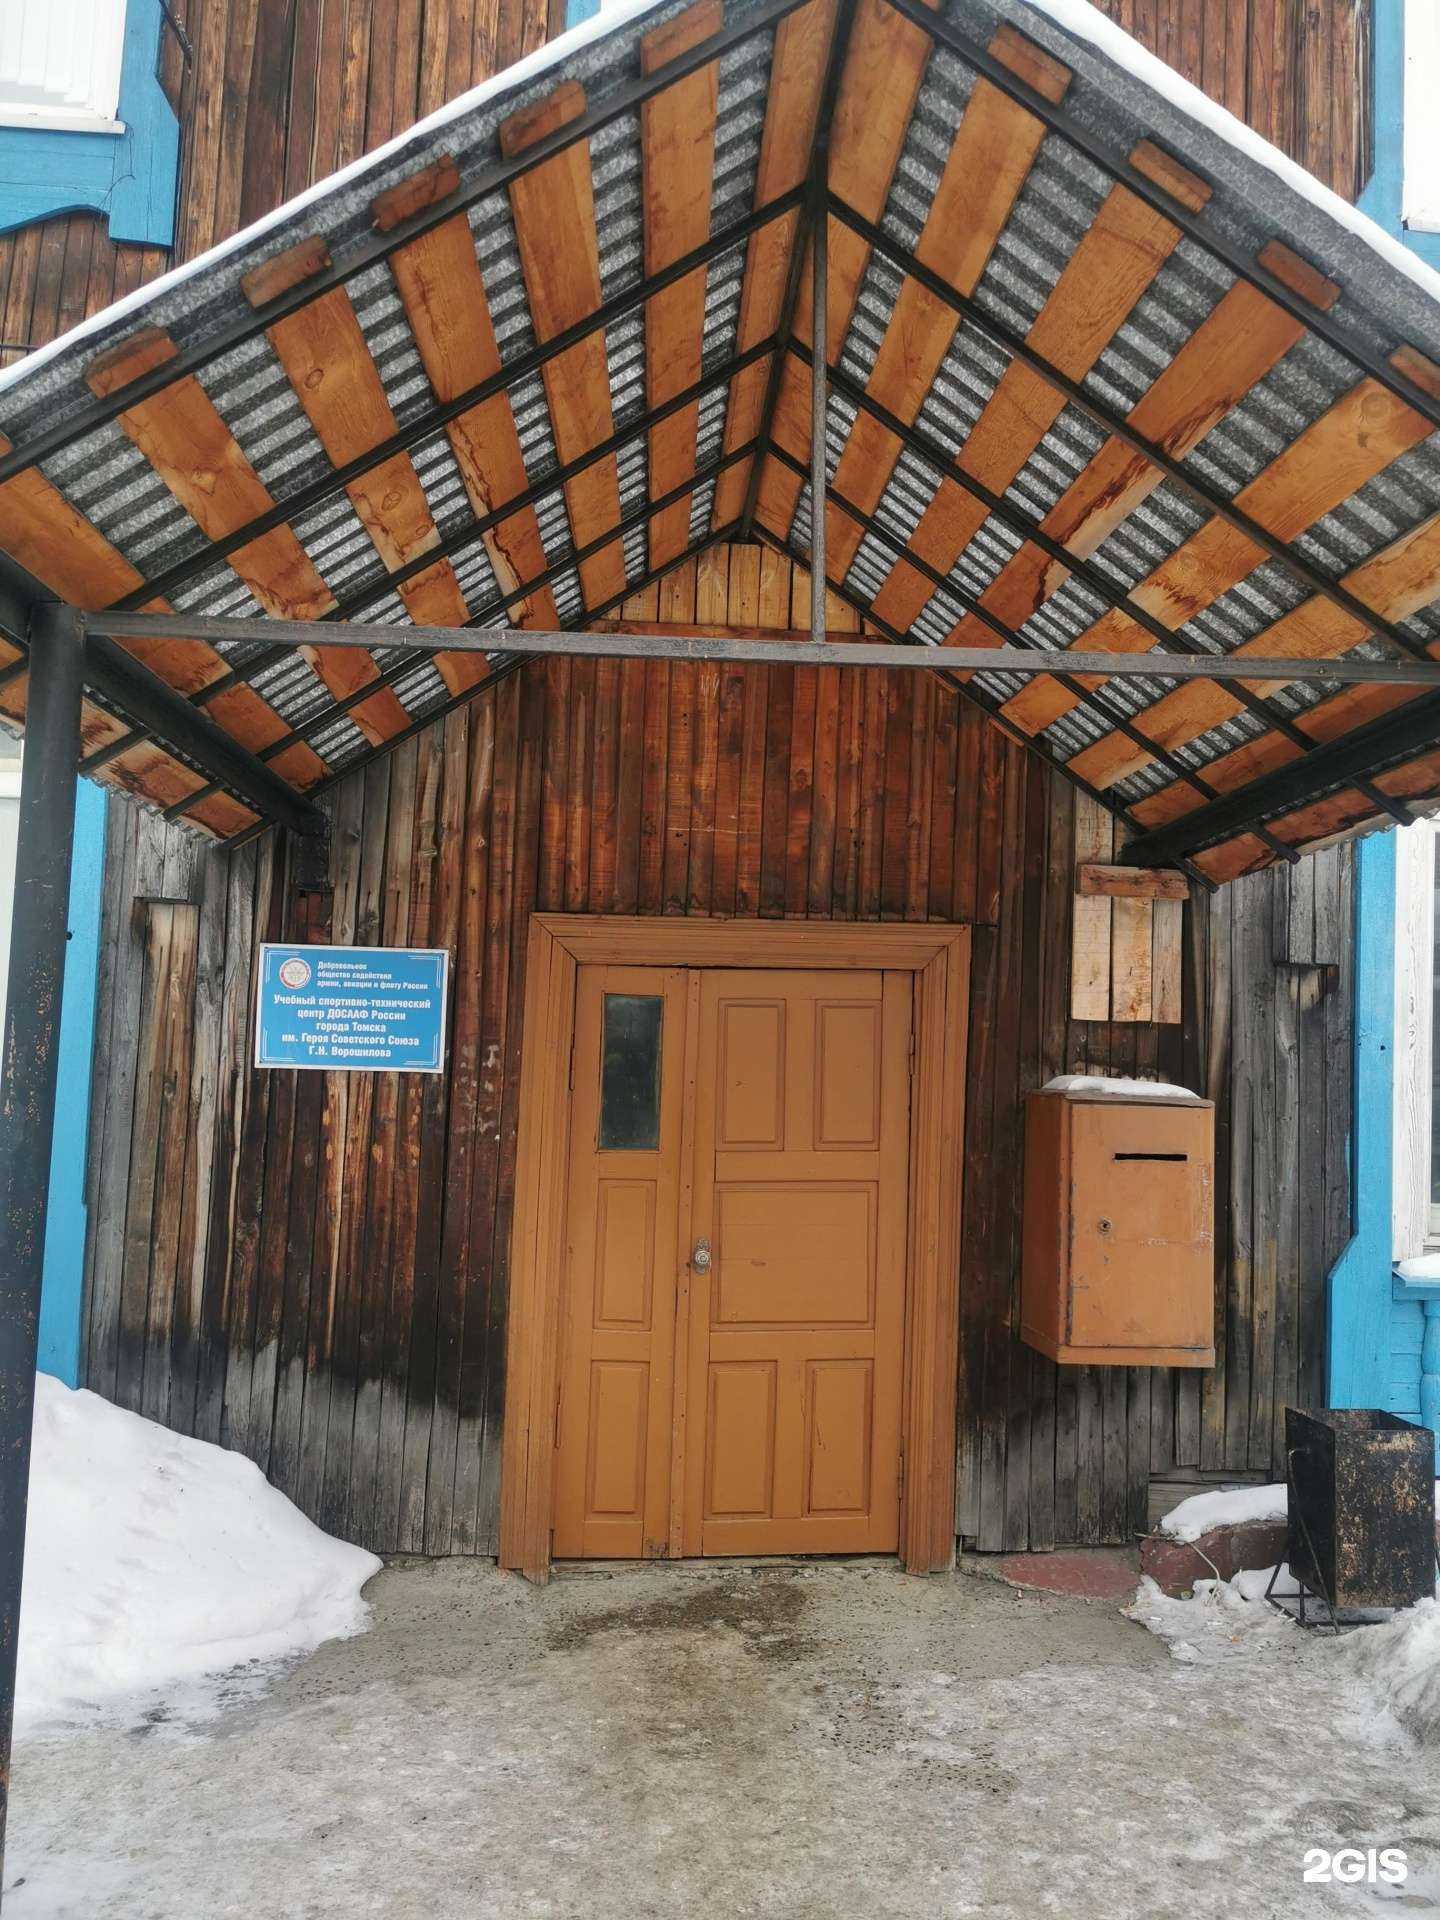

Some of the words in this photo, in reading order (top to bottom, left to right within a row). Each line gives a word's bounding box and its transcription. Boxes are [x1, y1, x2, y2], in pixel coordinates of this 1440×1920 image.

[380, 981, 401, 990] флоту
[402, 982, 428, 990] России
[274, 994, 316, 1005] Учебный
[318, 997, 431, 1009] спортивно-технический
[297, 1009, 325, 1019] центр
[327, 1009, 368, 1020] ДОСААФ
[371, 1011, 406, 1020] России
[316, 1022, 349, 1032] города
[352, 1022, 386, 1032] Томска
[282, 1034, 298, 1042] им.
[301, 1033, 328, 1044] Героя
[331, 1034, 385, 1045] Советского
[388, 1035, 420, 1046] Союза
[331, 1046, 392, 1058] Ворошилова
